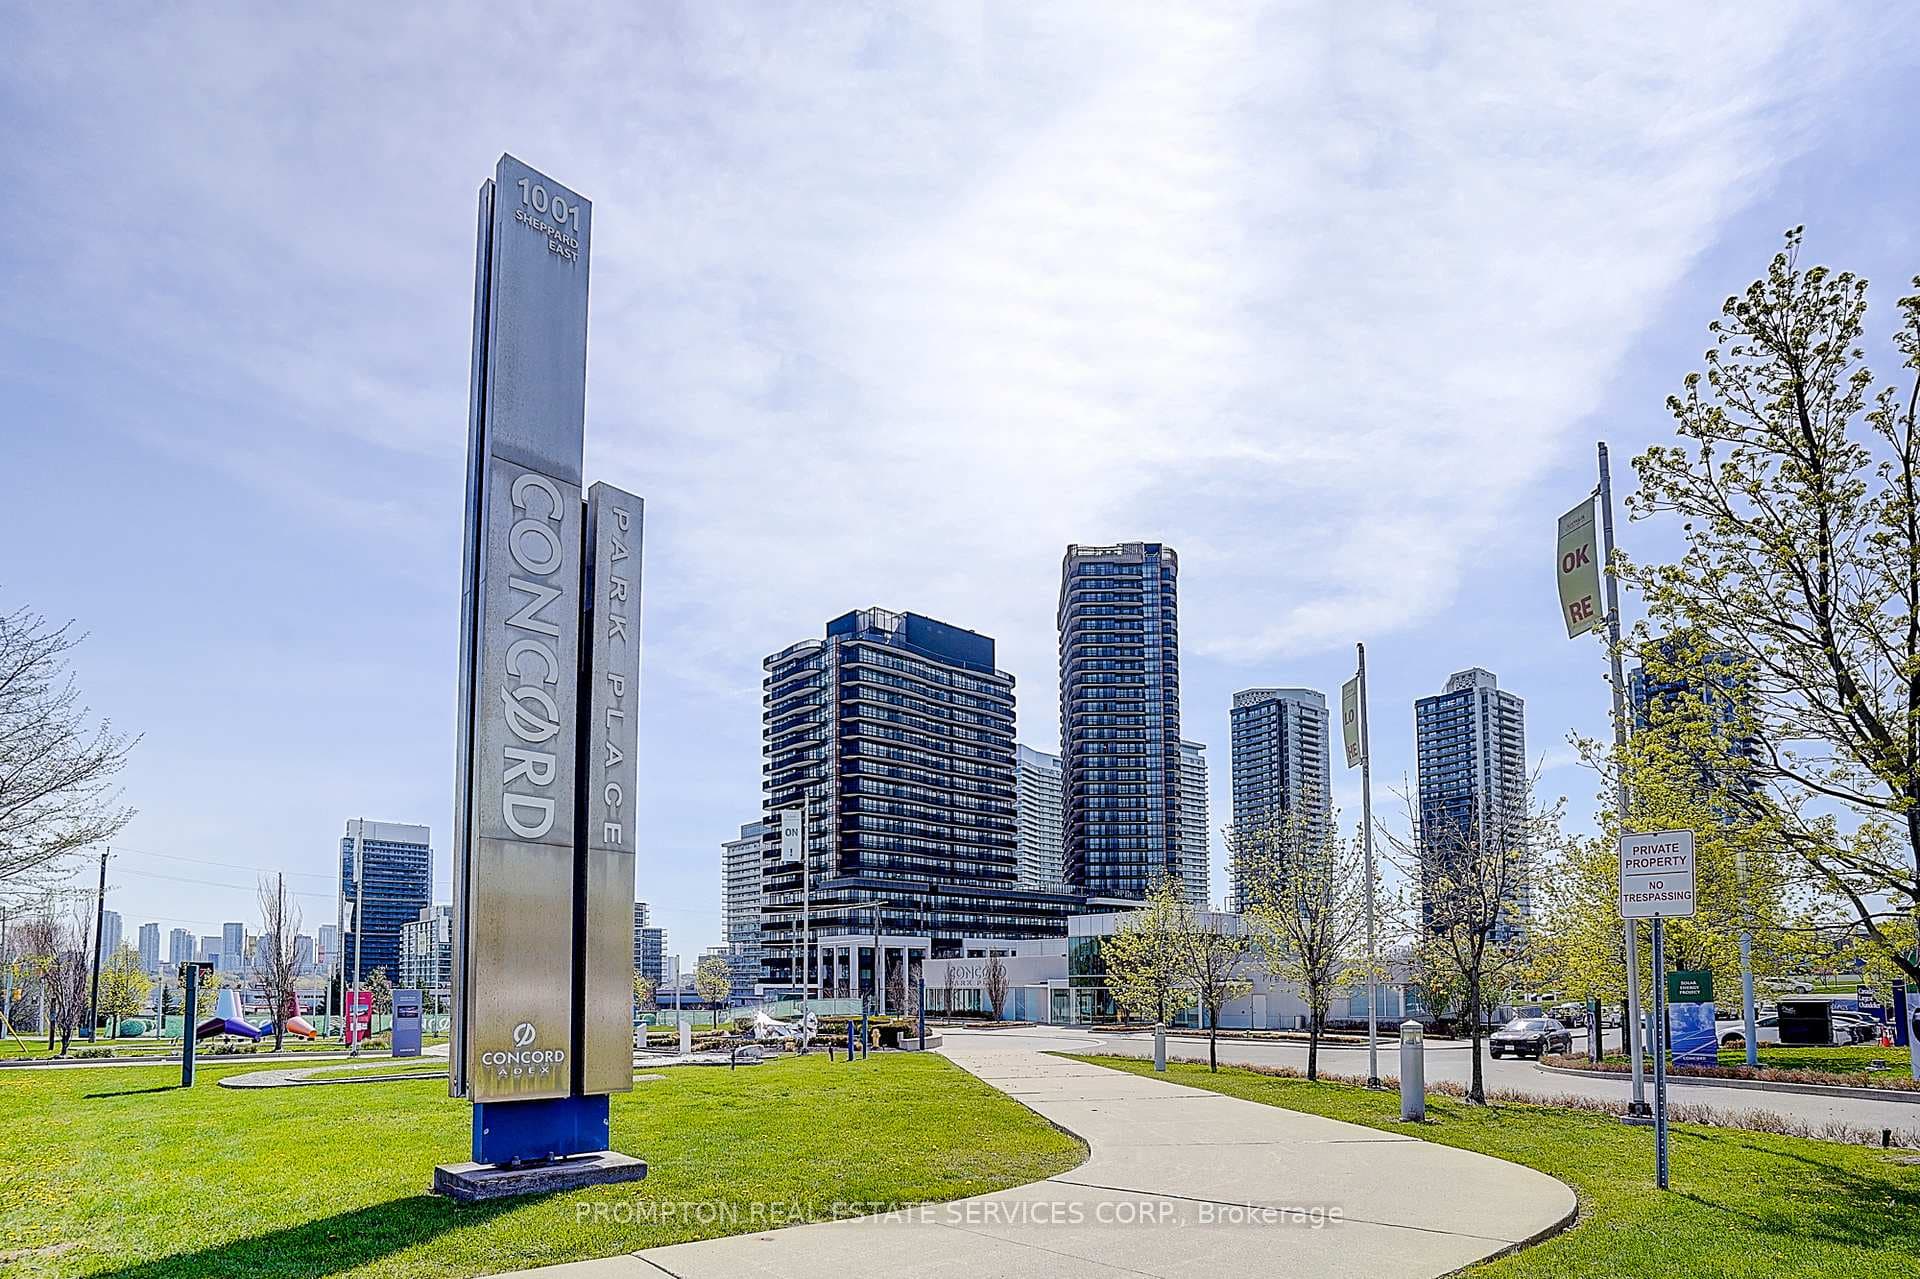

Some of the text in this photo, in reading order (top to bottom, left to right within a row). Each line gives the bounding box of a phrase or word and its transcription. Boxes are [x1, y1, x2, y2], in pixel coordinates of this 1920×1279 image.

[518, 178, 579, 232] 1001
[515, 209, 579, 249] SHEPPARD
[549, 240, 579, 262] EAST
[1562, 543, 1590, 574] OK
[1569, 595, 1594, 624] RE
[602, 506, 630, 845] PARK PLACE
[1344, 709, 1355, 726] LO
[785, 828, 798, 837] ON
[1632, 843, 1680, 855] PRIVATE
[1625, 856, 1687, 868] PROPERTY
[1648, 881, 1664, 889] NO
[1623, 891, 1692, 902] TRESPASSING
[482, 1050, 565, 1065] CONCORD
[498, 1066, 549, 1075] ADEX
